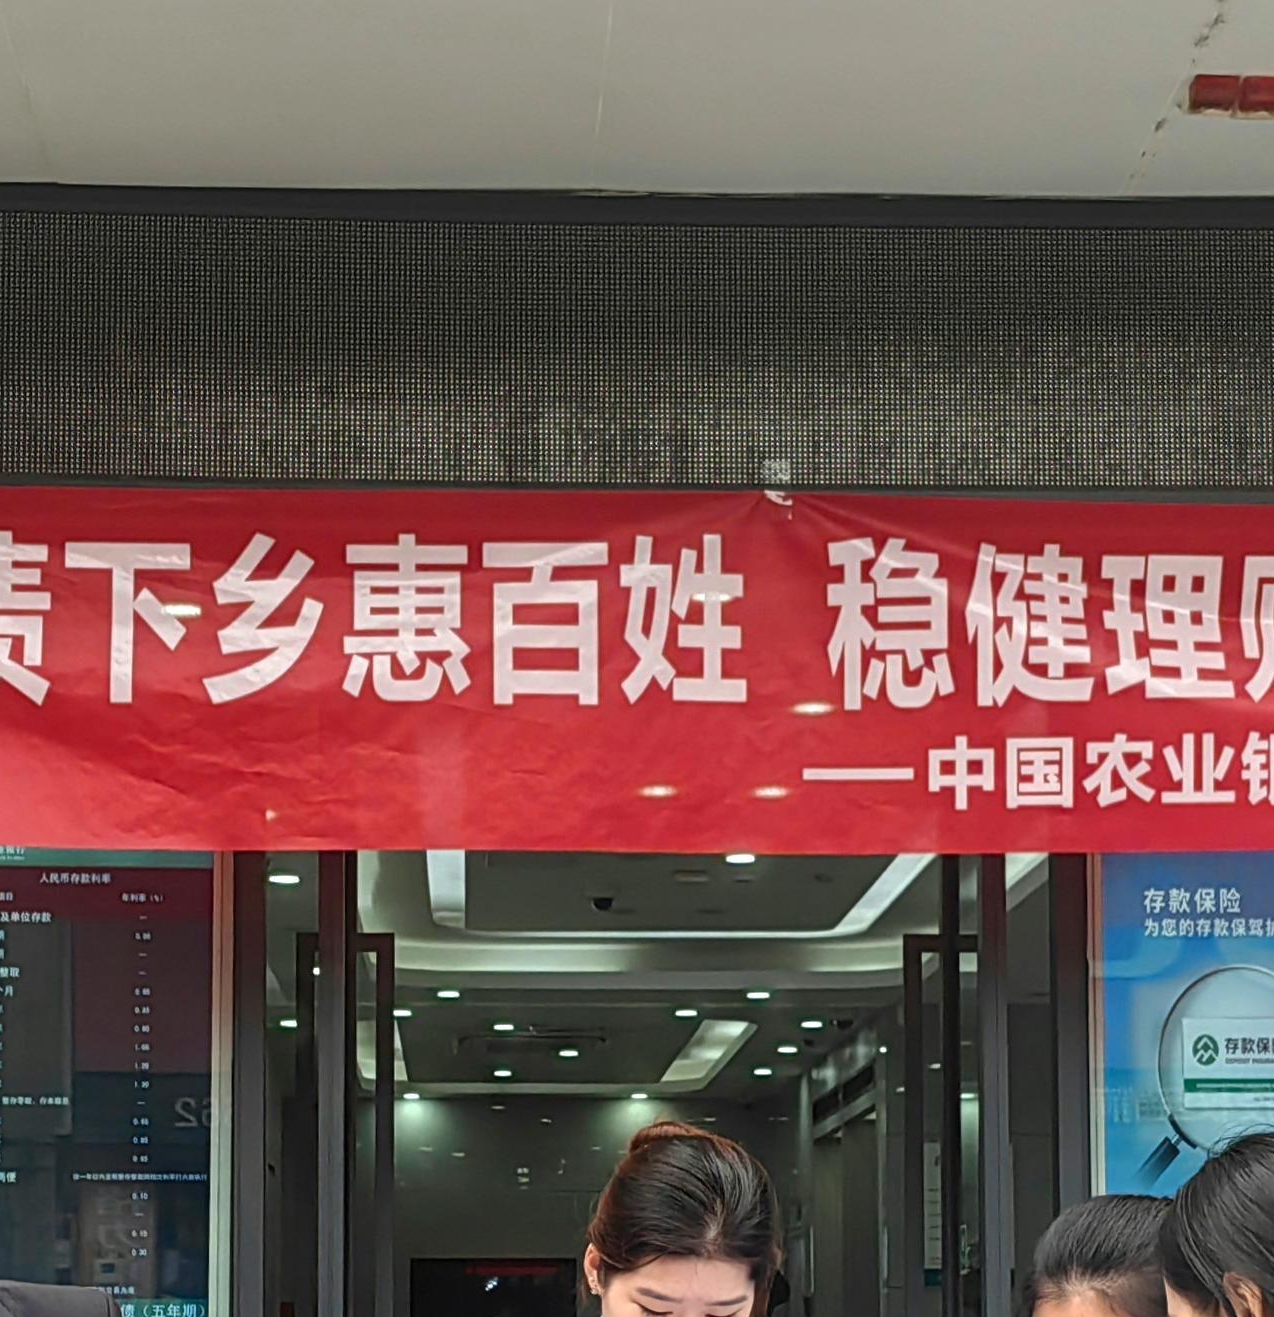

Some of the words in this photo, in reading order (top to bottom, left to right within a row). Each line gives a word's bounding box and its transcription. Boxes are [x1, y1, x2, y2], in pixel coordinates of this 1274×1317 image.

[39, 872, 111, 885] 人民币存款利率
[1143, 887, 1242, 915] 存款保险
